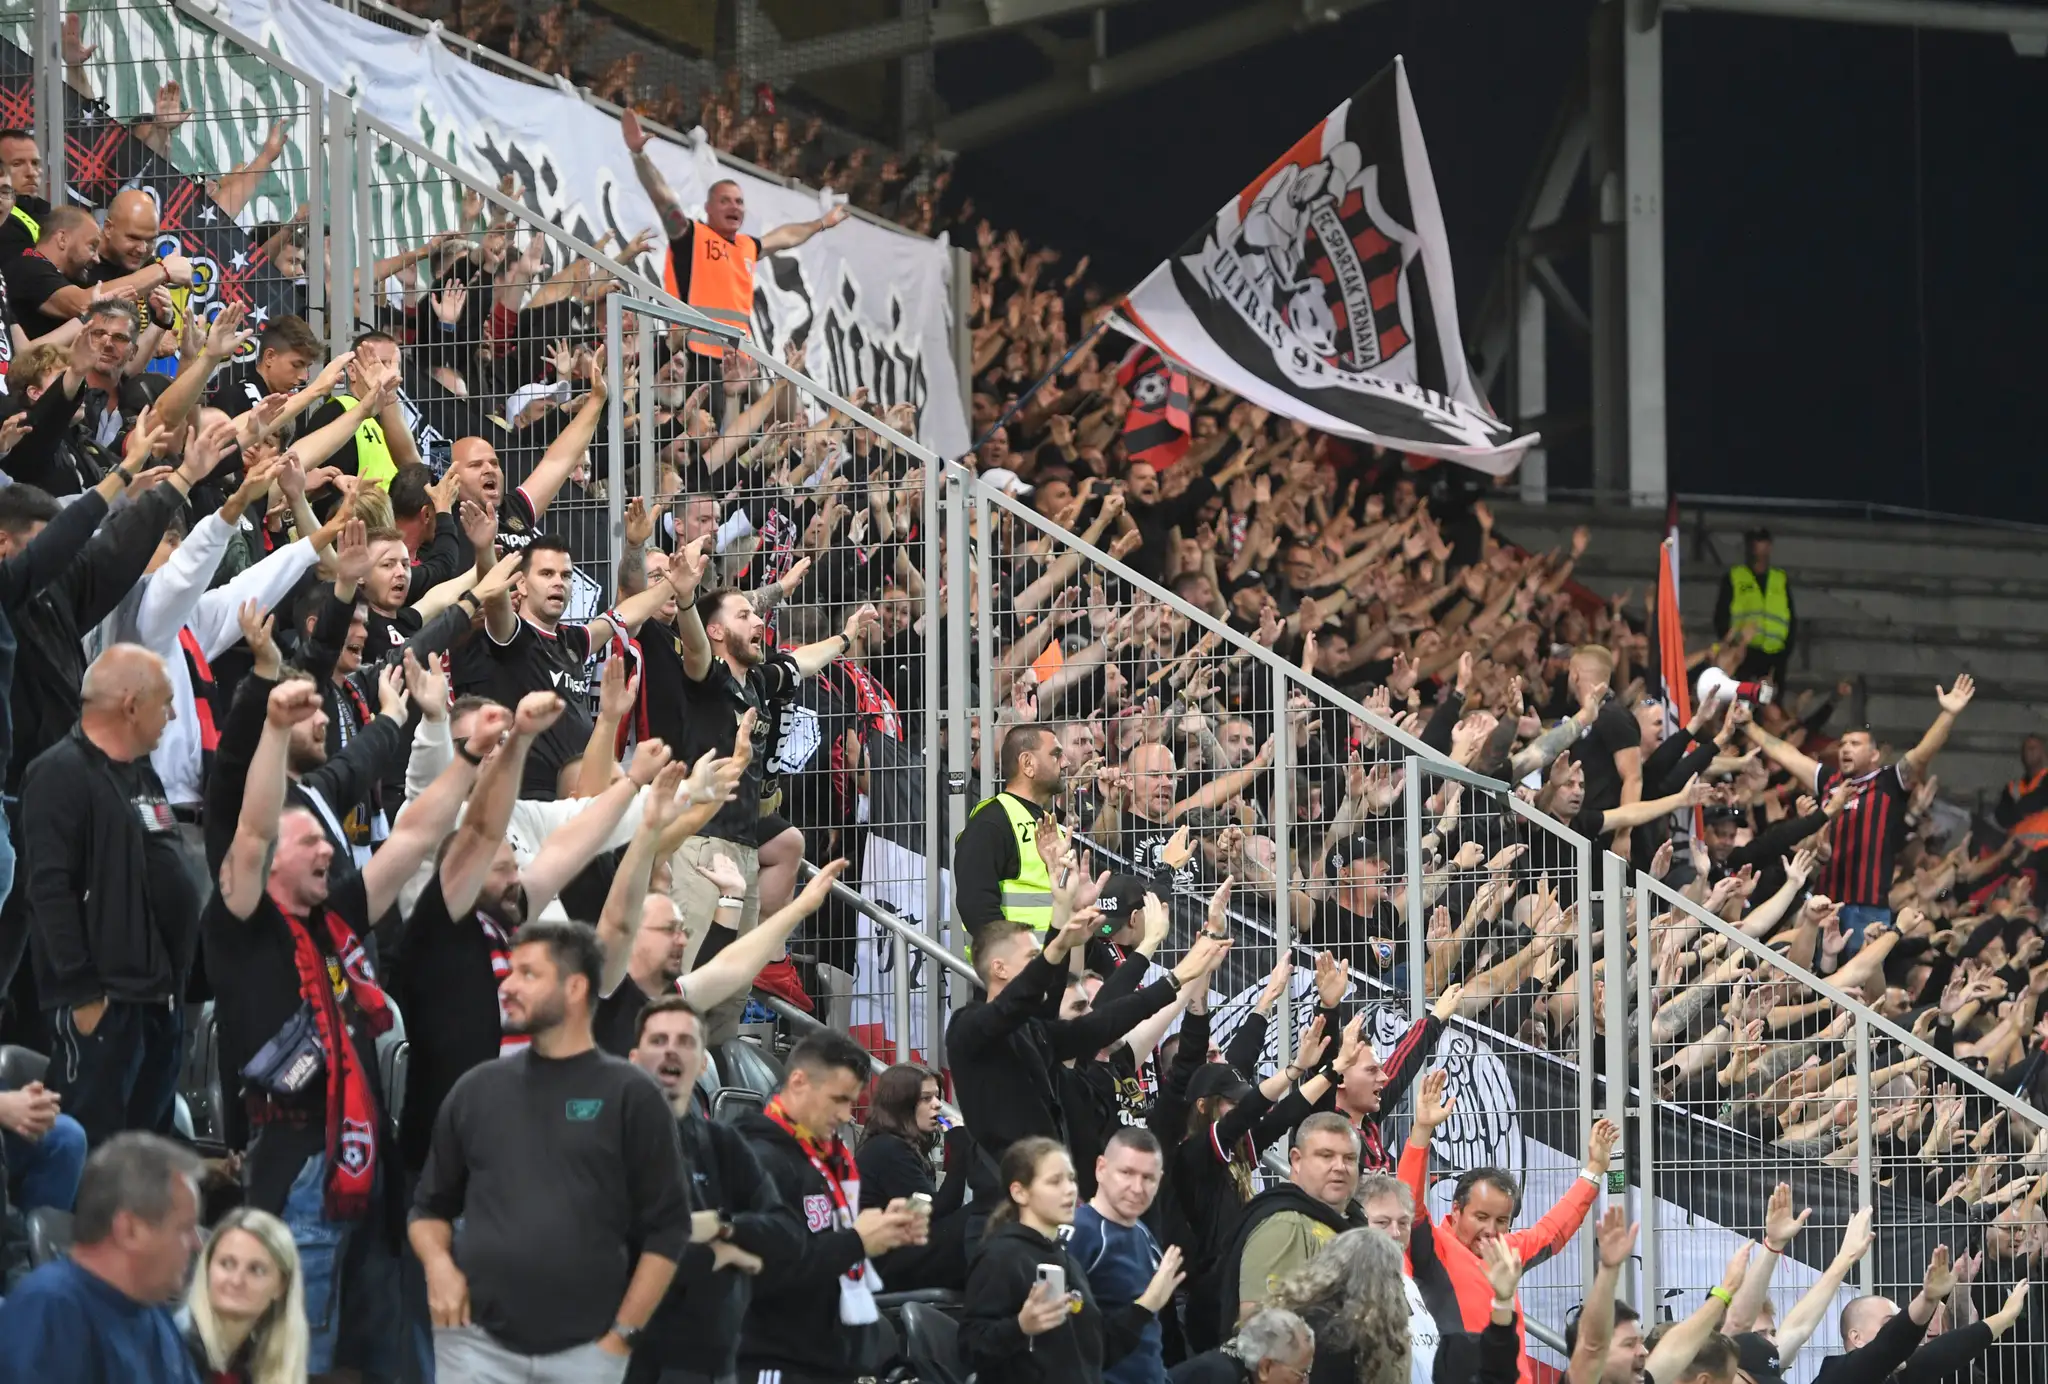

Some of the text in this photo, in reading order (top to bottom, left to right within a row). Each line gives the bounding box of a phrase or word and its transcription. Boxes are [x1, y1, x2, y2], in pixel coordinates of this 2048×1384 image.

[1213, 248, 1284, 349] ULTRAS
[1315, 211, 1376, 366] FC SPARTAK TRNAVA
[363, 424, 382, 445] 41
